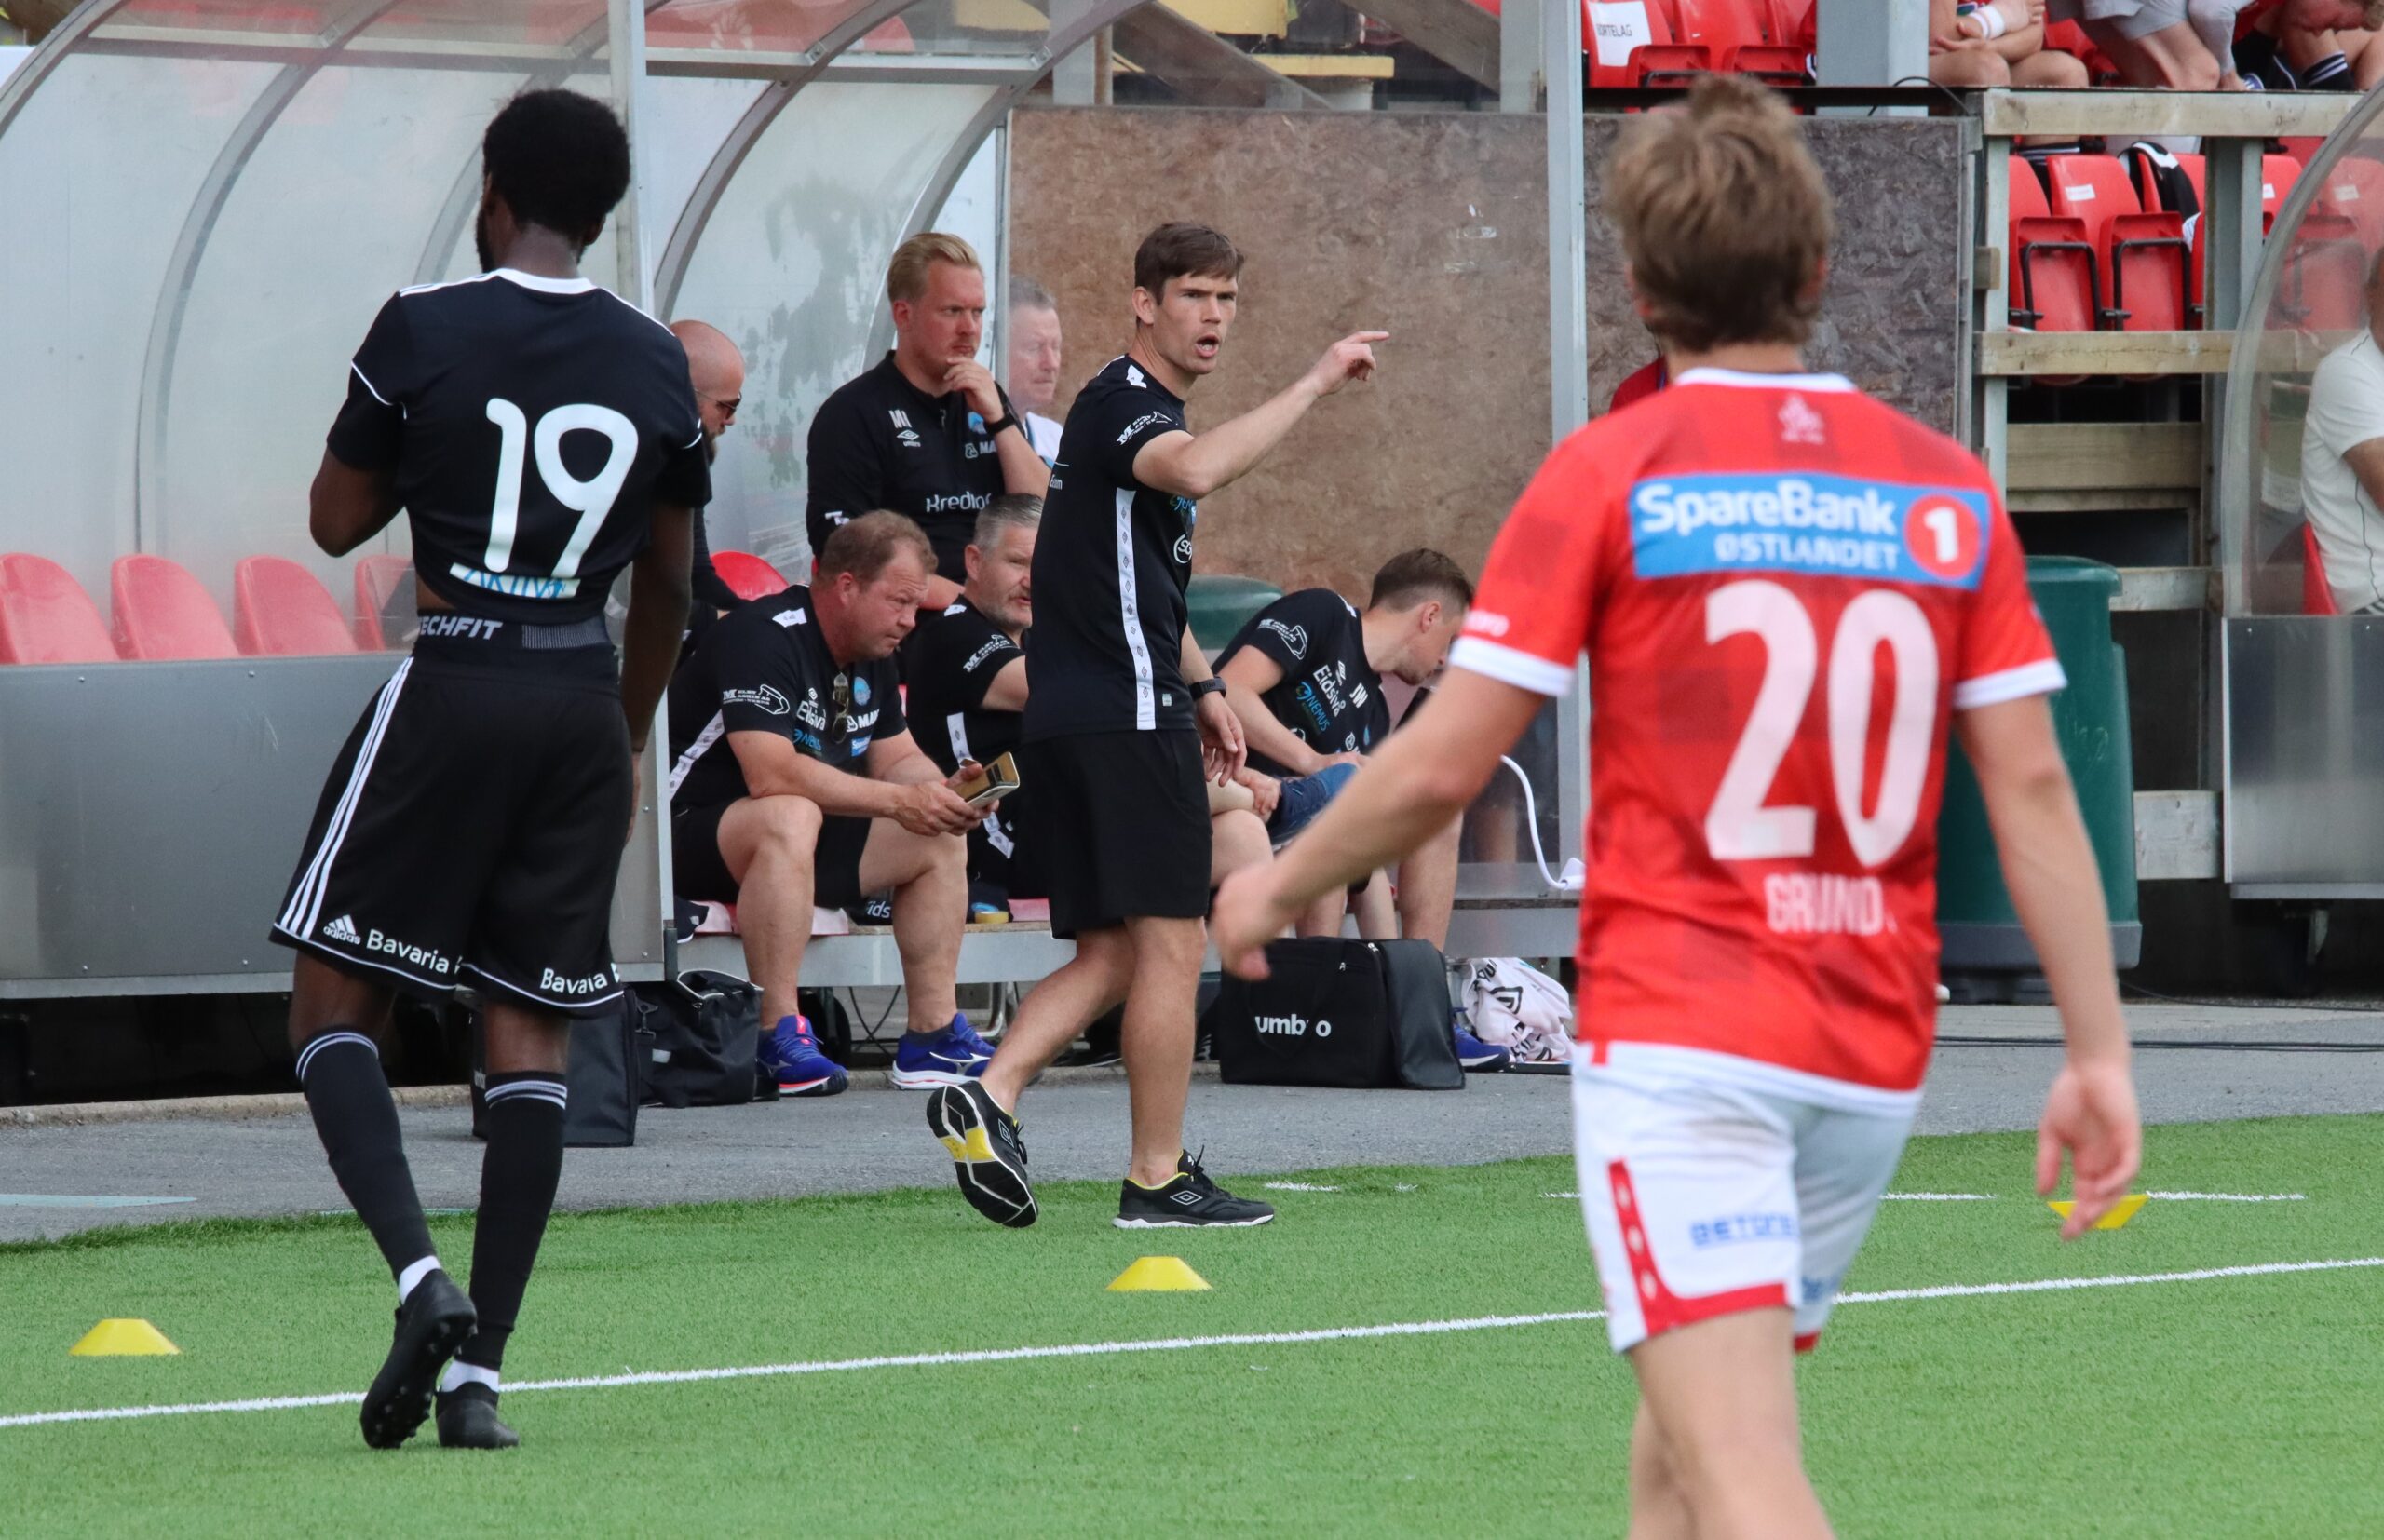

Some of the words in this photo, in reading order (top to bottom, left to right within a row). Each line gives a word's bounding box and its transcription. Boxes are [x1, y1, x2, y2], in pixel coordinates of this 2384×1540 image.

[484, 398, 639, 578] 19
[1636, 480, 1898, 536] SpareBank
[1923, 506, 1959, 564] 1
[1714, 531, 1901, 572] ØSTLANDET
[1704, 579, 1939, 868] 20
[323, 925, 361, 945] adidas
[366, 928, 450, 974] Bavaria
[540, 967, 608, 995] Bavaia
[1254, 1013, 1332, 1037] umbo
